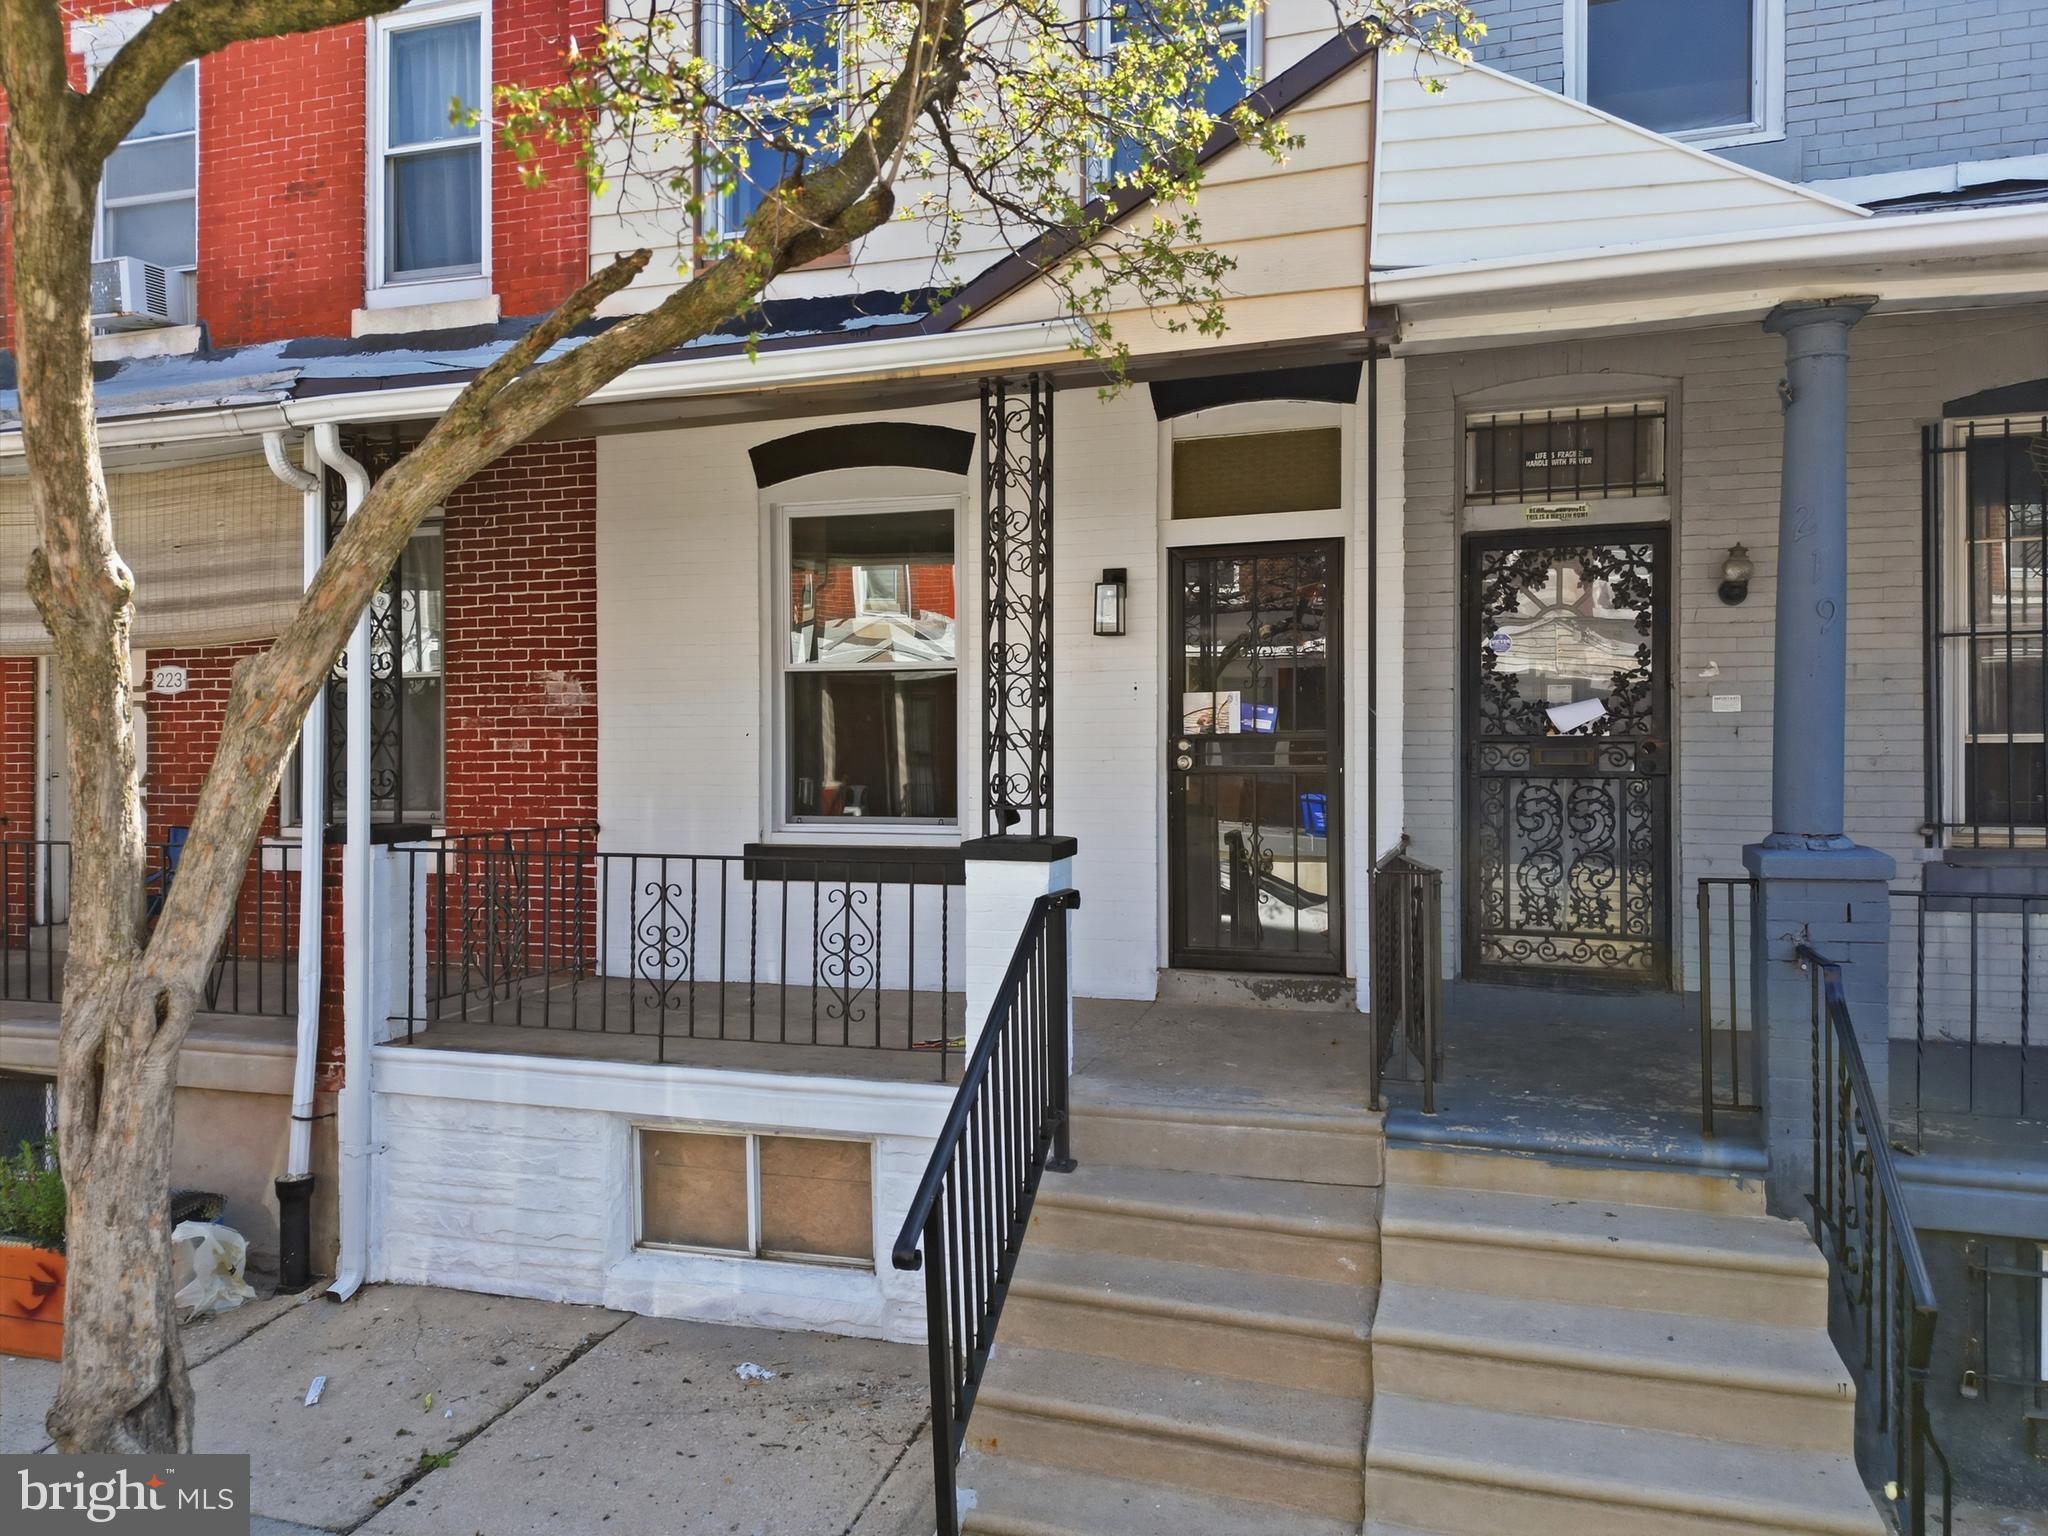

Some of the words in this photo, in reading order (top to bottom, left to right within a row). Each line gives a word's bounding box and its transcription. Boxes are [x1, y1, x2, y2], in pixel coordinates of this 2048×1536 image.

[1535, 451, 1547, 459] LIFE
[1526, 459, 1548, 467] HANDLE
[1551, 458, 1567, 466] WITH
[157, 672, 182, 688] 223
